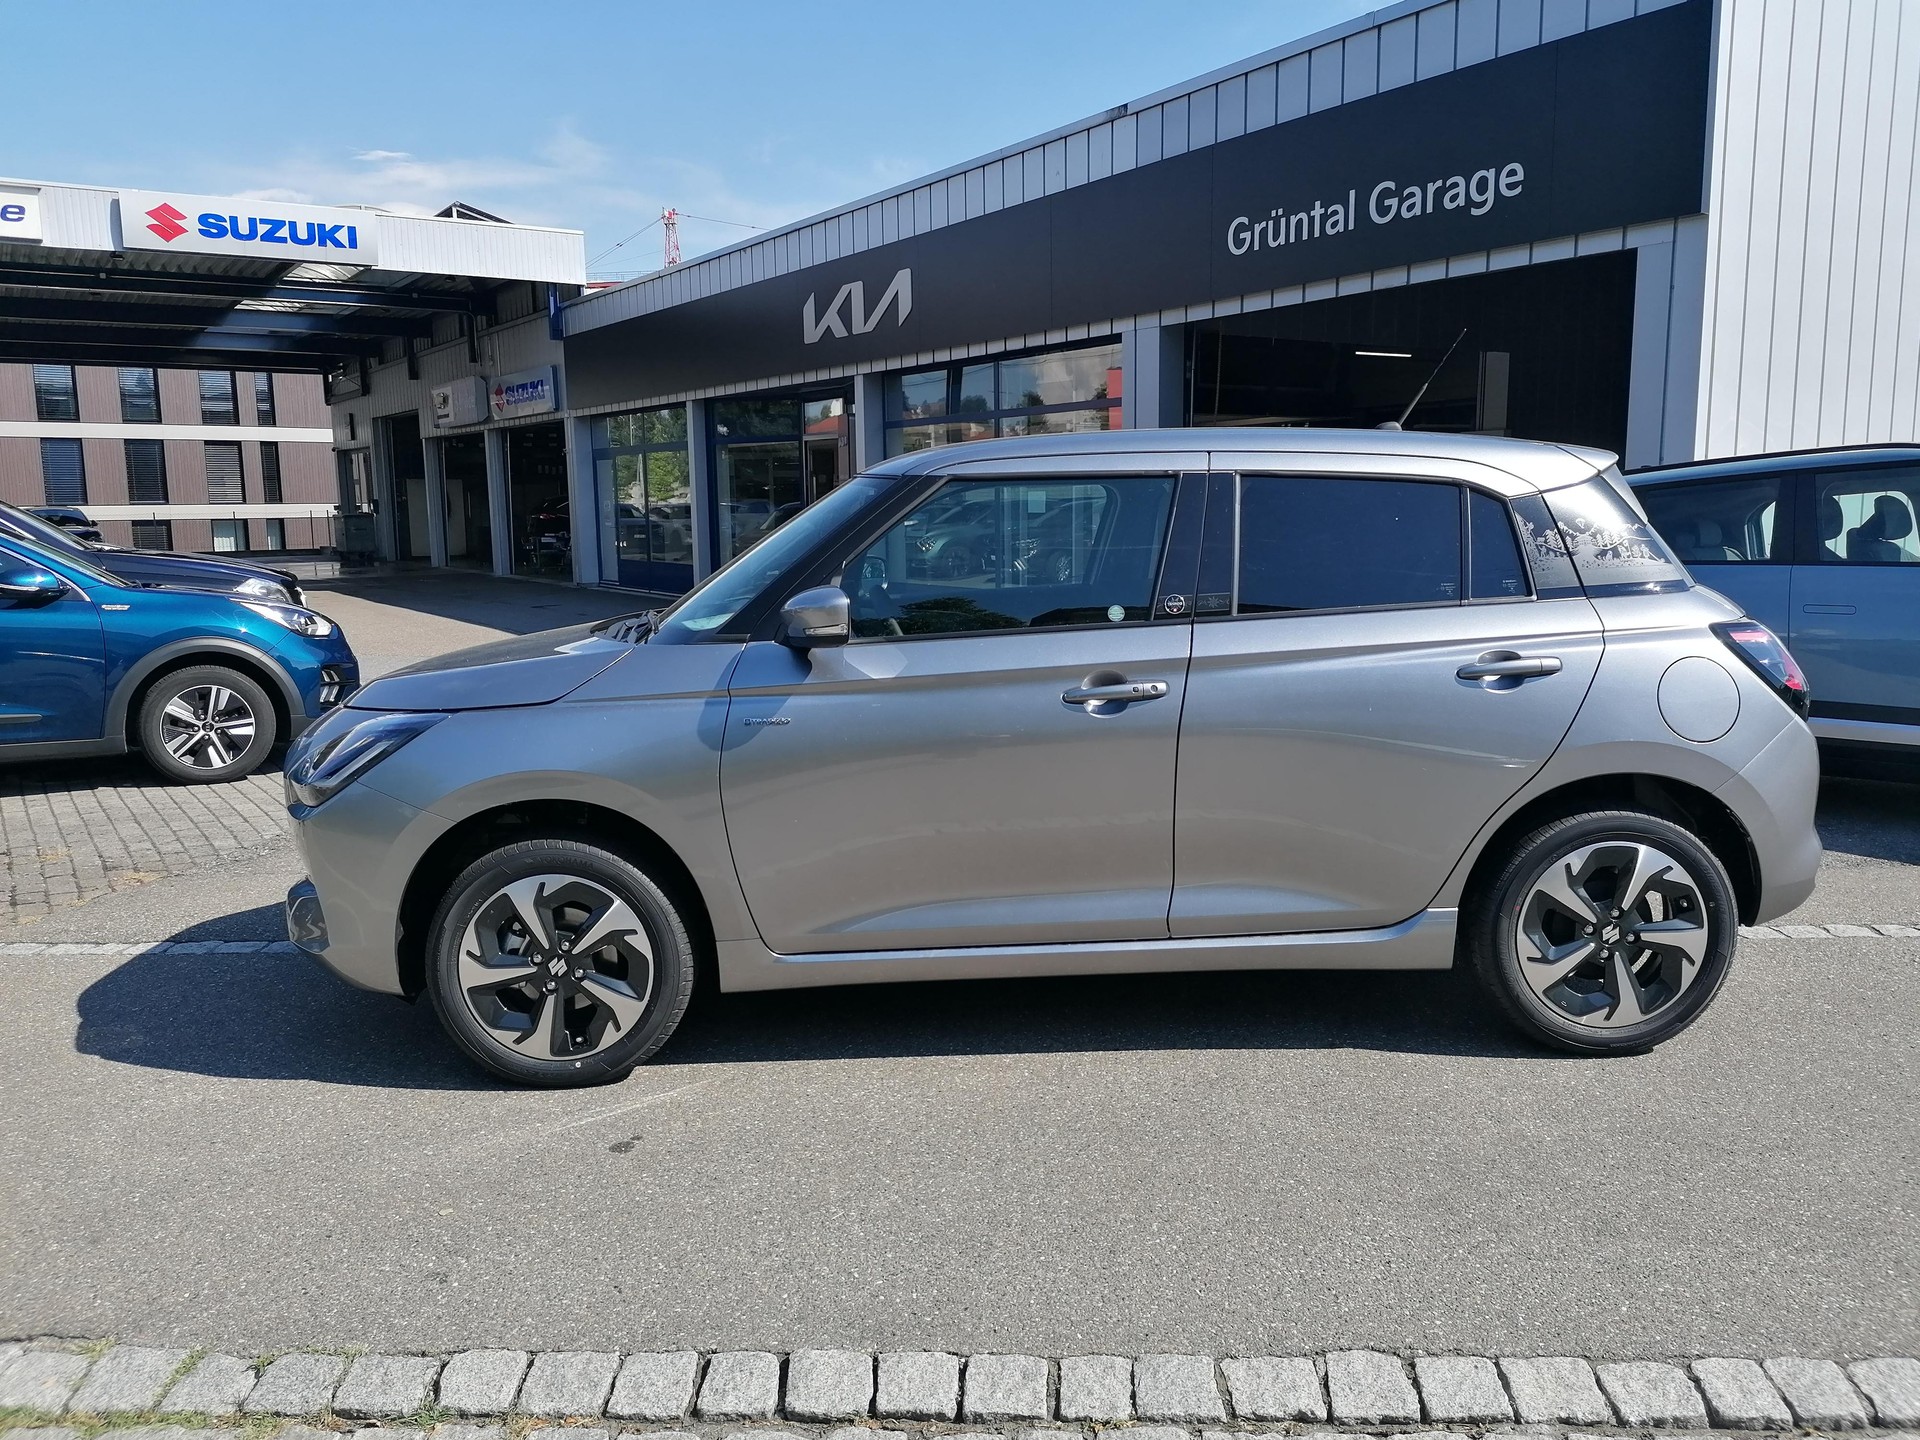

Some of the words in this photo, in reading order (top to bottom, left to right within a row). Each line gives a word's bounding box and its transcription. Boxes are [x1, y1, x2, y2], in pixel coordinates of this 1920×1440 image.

[197, 213, 358, 249] SUZUKI
[1227, 189, 1356, 256] Grüntal
[1368, 162, 1525, 217] Garage
[803, 267, 912, 345] KIA
[504, 379, 546, 405] SUZUKI
